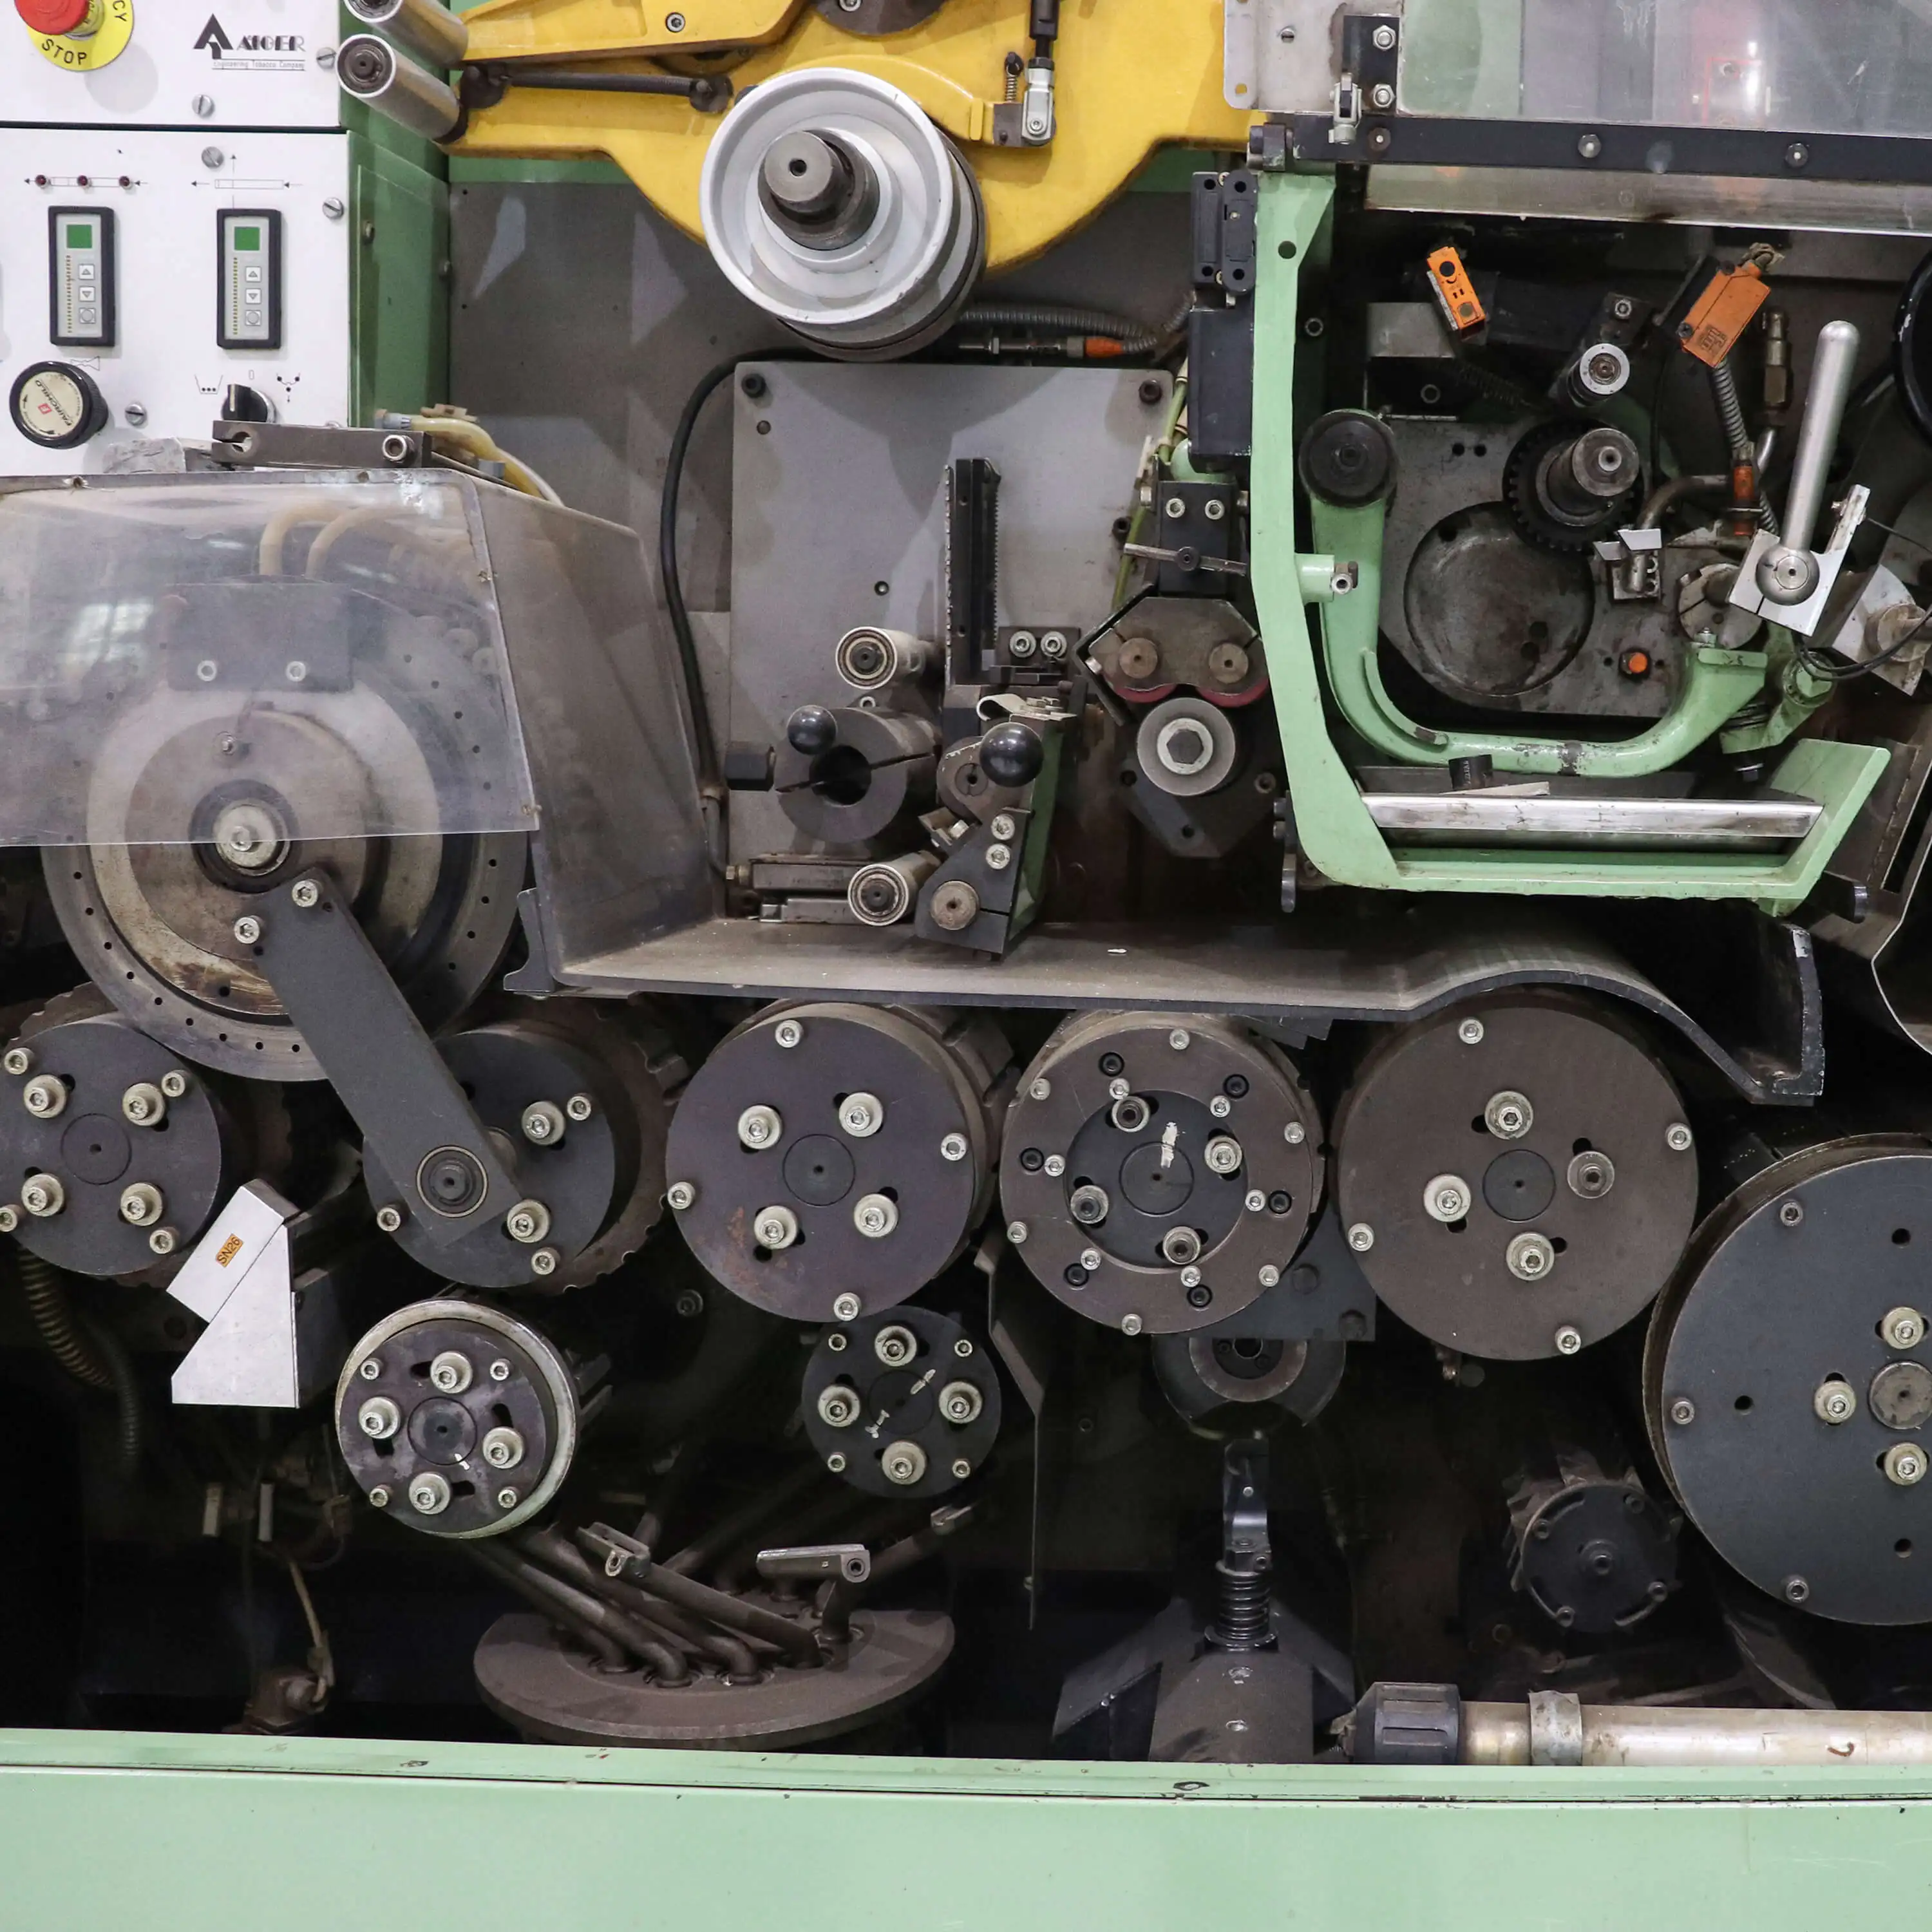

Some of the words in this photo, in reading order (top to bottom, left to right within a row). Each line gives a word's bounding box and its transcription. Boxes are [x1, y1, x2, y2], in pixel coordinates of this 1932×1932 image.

[41, 39, 88, 65] STOP
[35, 379, 73, 426] FAIRCHILD
[217, 1236, 240, 1264] SN26
